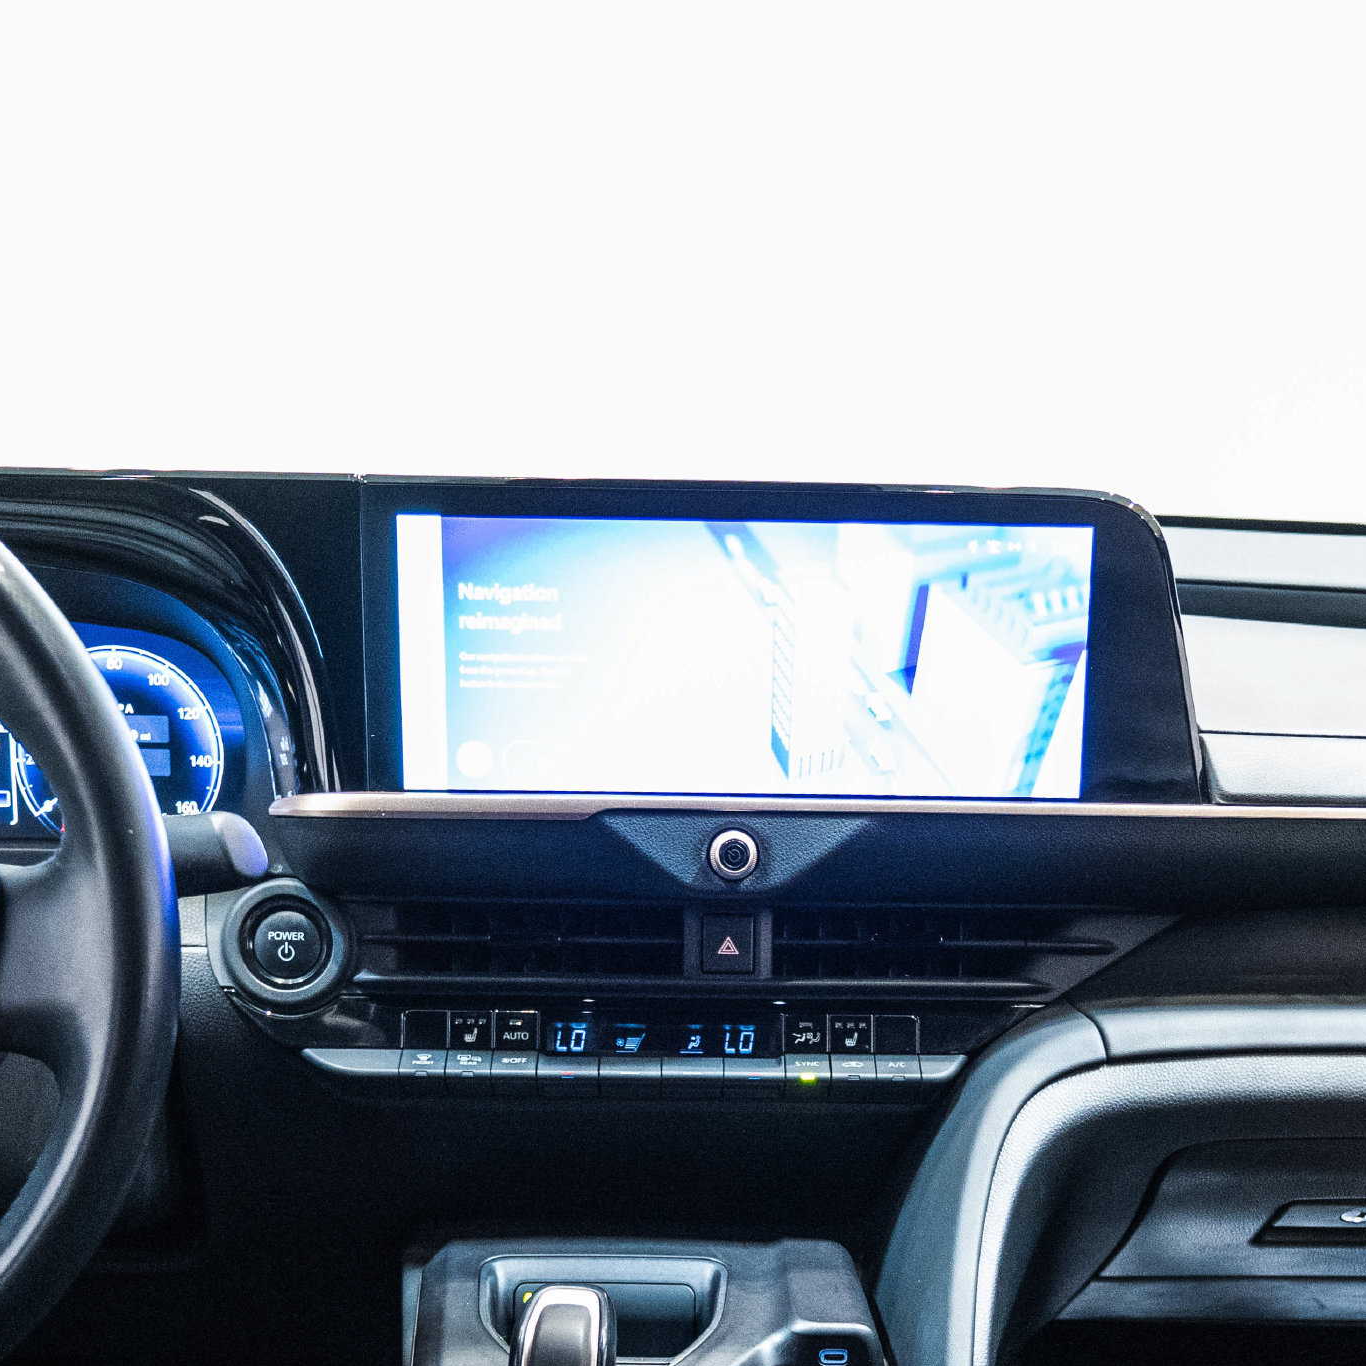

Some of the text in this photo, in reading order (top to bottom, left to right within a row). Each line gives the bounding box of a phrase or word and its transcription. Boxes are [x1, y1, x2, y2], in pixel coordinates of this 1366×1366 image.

[458, 582, 559, 606] Navigation
[147, 674, 170, 686] 100
[178, 707, 201, 720] 120
[190, 754, 212, 768] 140
[267, 931, 305, 941] POWER
[503, 1031, 529, 1040] AUTO
